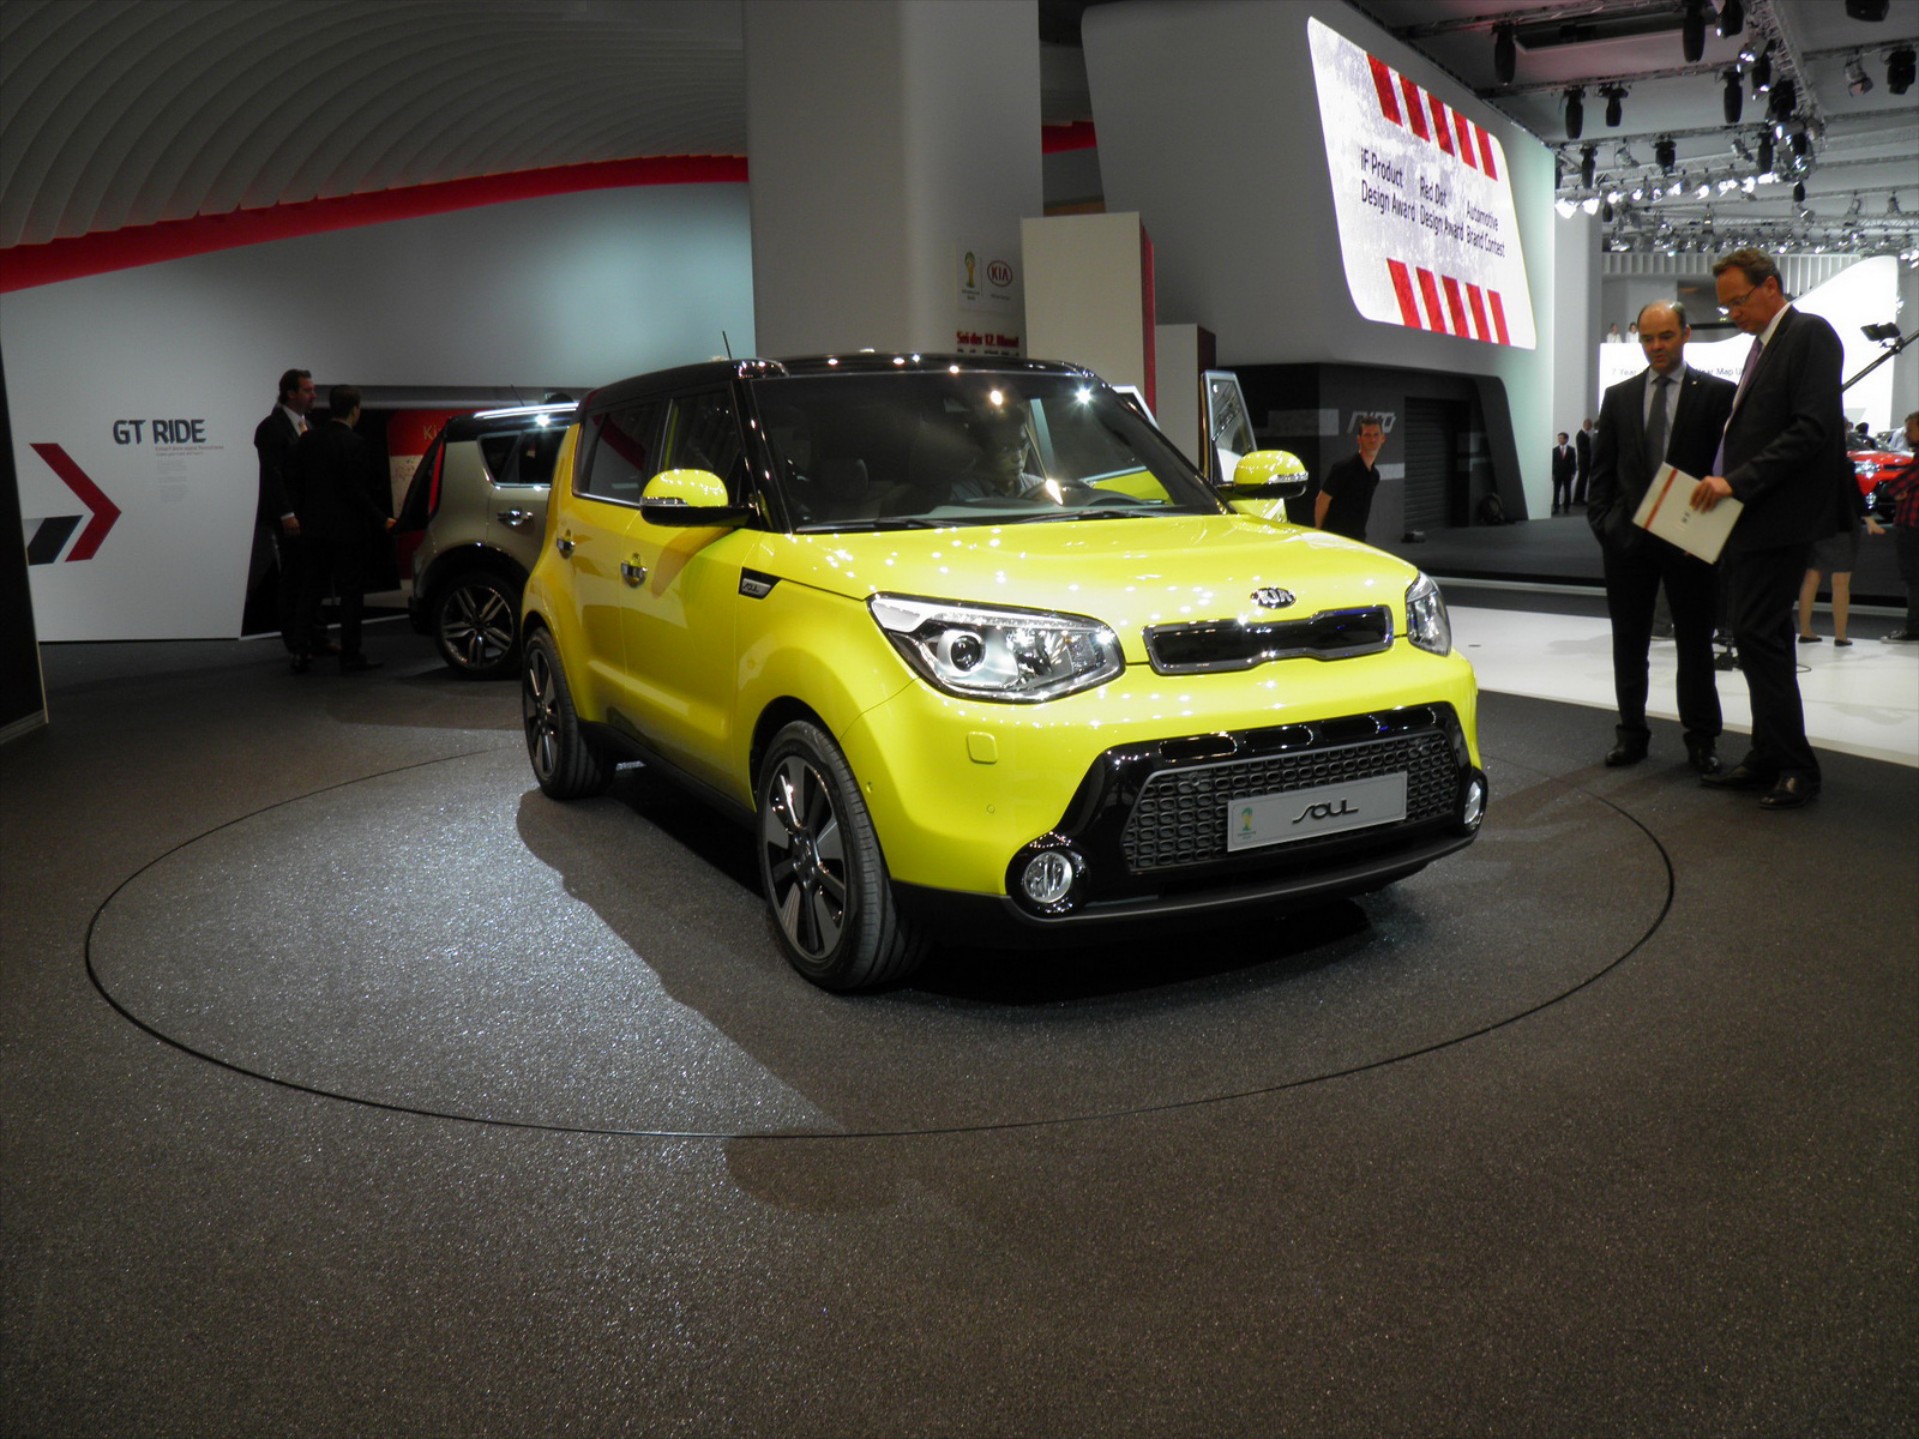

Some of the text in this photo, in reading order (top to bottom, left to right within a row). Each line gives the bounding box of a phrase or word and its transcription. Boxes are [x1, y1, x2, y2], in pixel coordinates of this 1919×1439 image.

[1371, 152, 1404, 188] Product
[1361, 179, 1416, 222] Design Award
[1420, 176, 1447, 208] Red Dot
[1420, 204, 1464, 241] Design Award
[1466, 200, 1499, 231] Automotive
[1466, 224, 1505, 257] Brand Contest
[112, 419, 207, 445] GT RIDE
